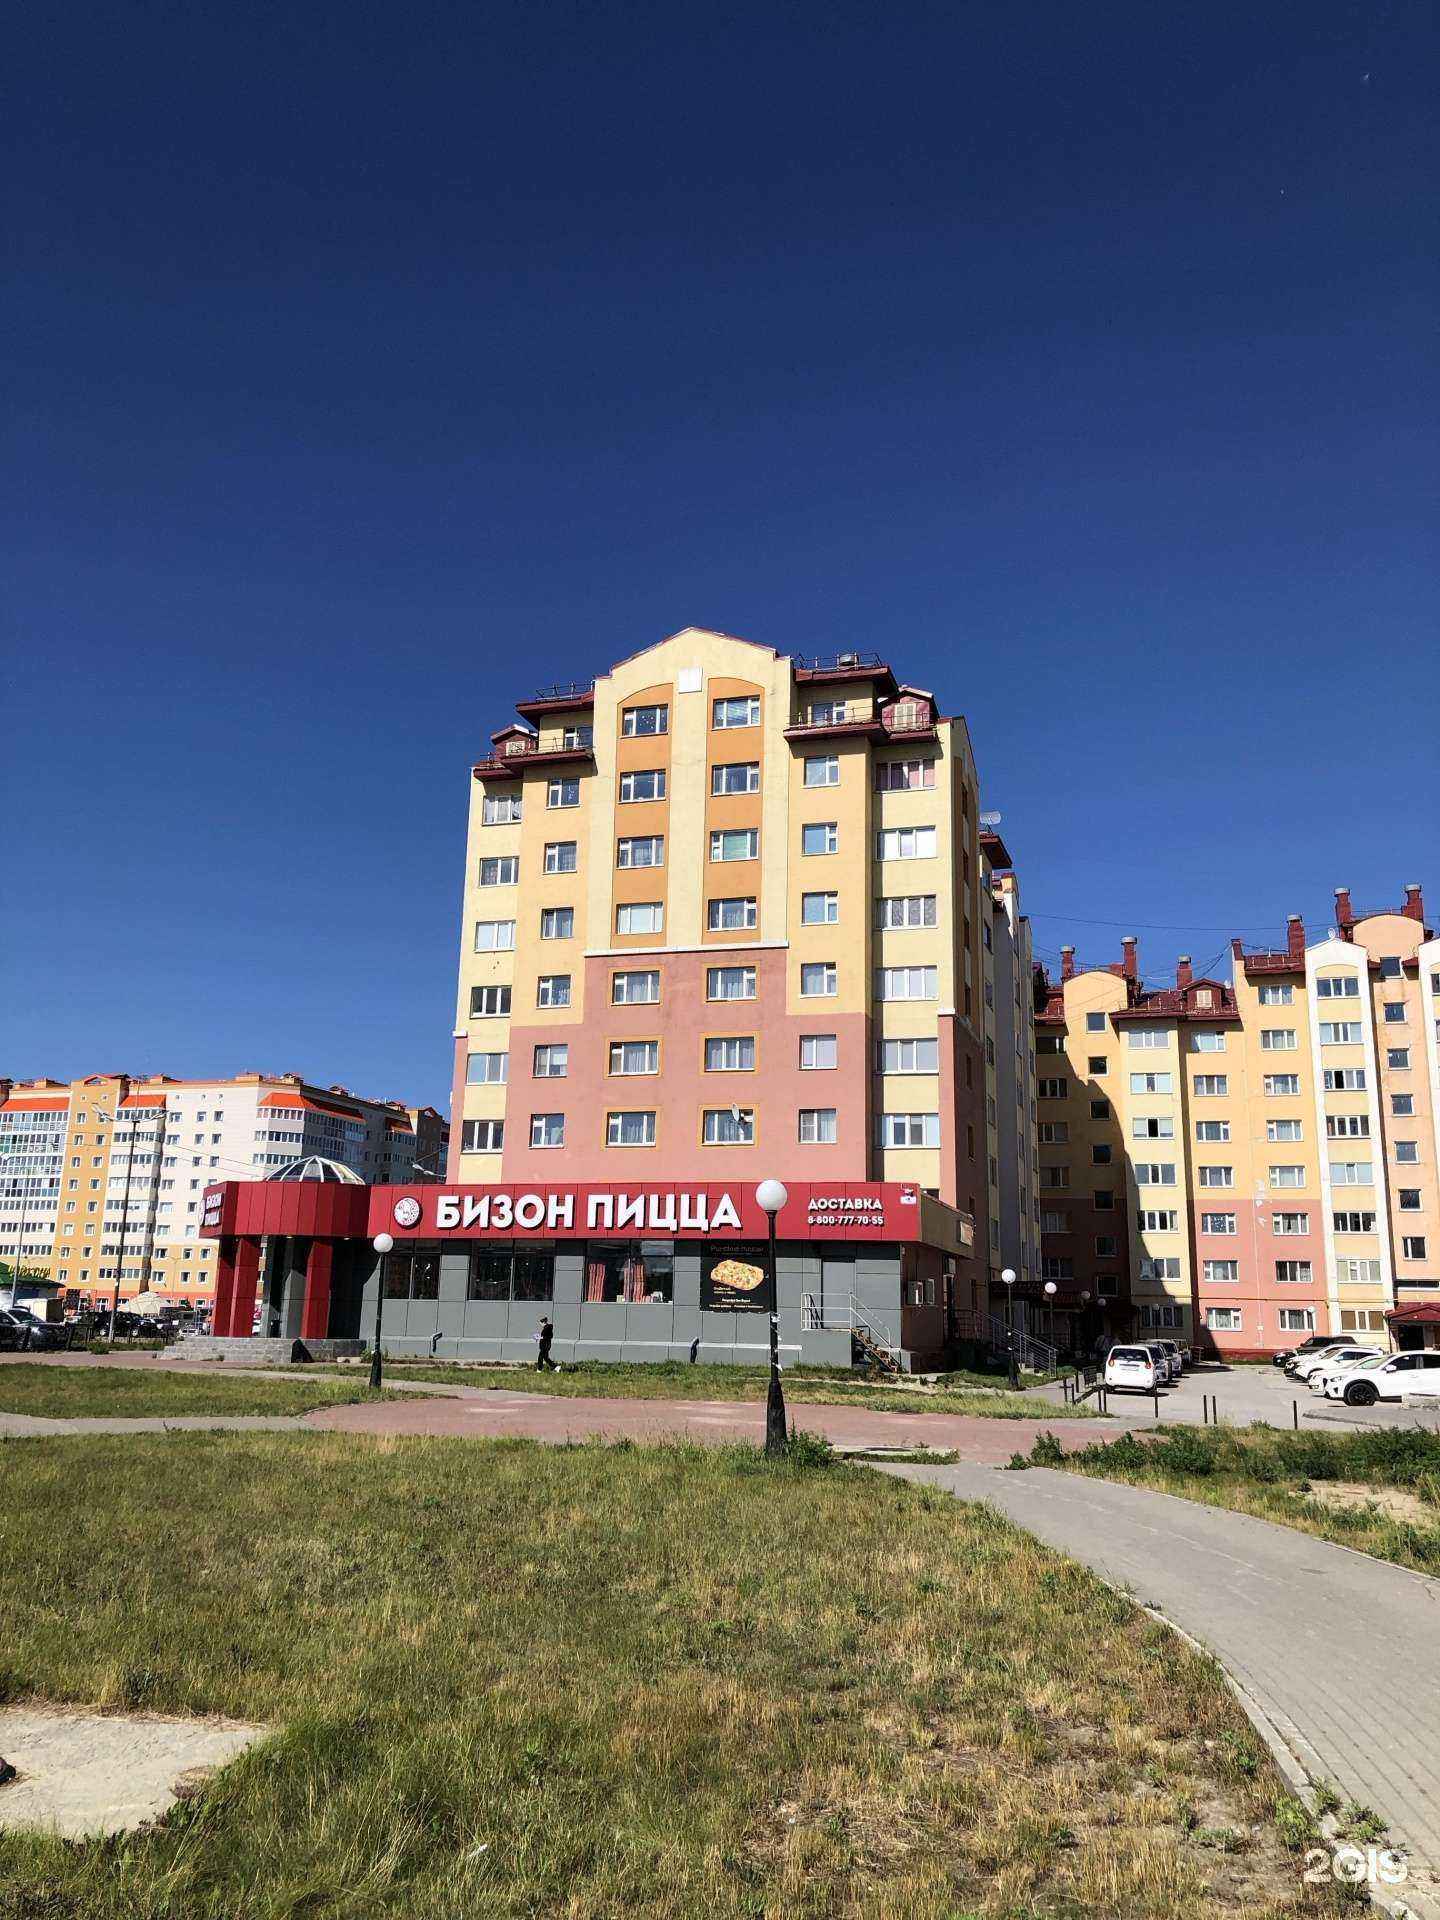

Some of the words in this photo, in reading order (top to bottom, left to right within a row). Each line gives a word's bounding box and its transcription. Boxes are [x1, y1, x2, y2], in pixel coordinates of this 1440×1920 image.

[808, 1198, 883, 1211] ДОСТАВКА
[436, 1194, 575, 1229] БИЗОН
[586, 1193, 743, 1232] ПИЦЦА
[807, 1215, 884, 1226] 8-800-777-70-55
